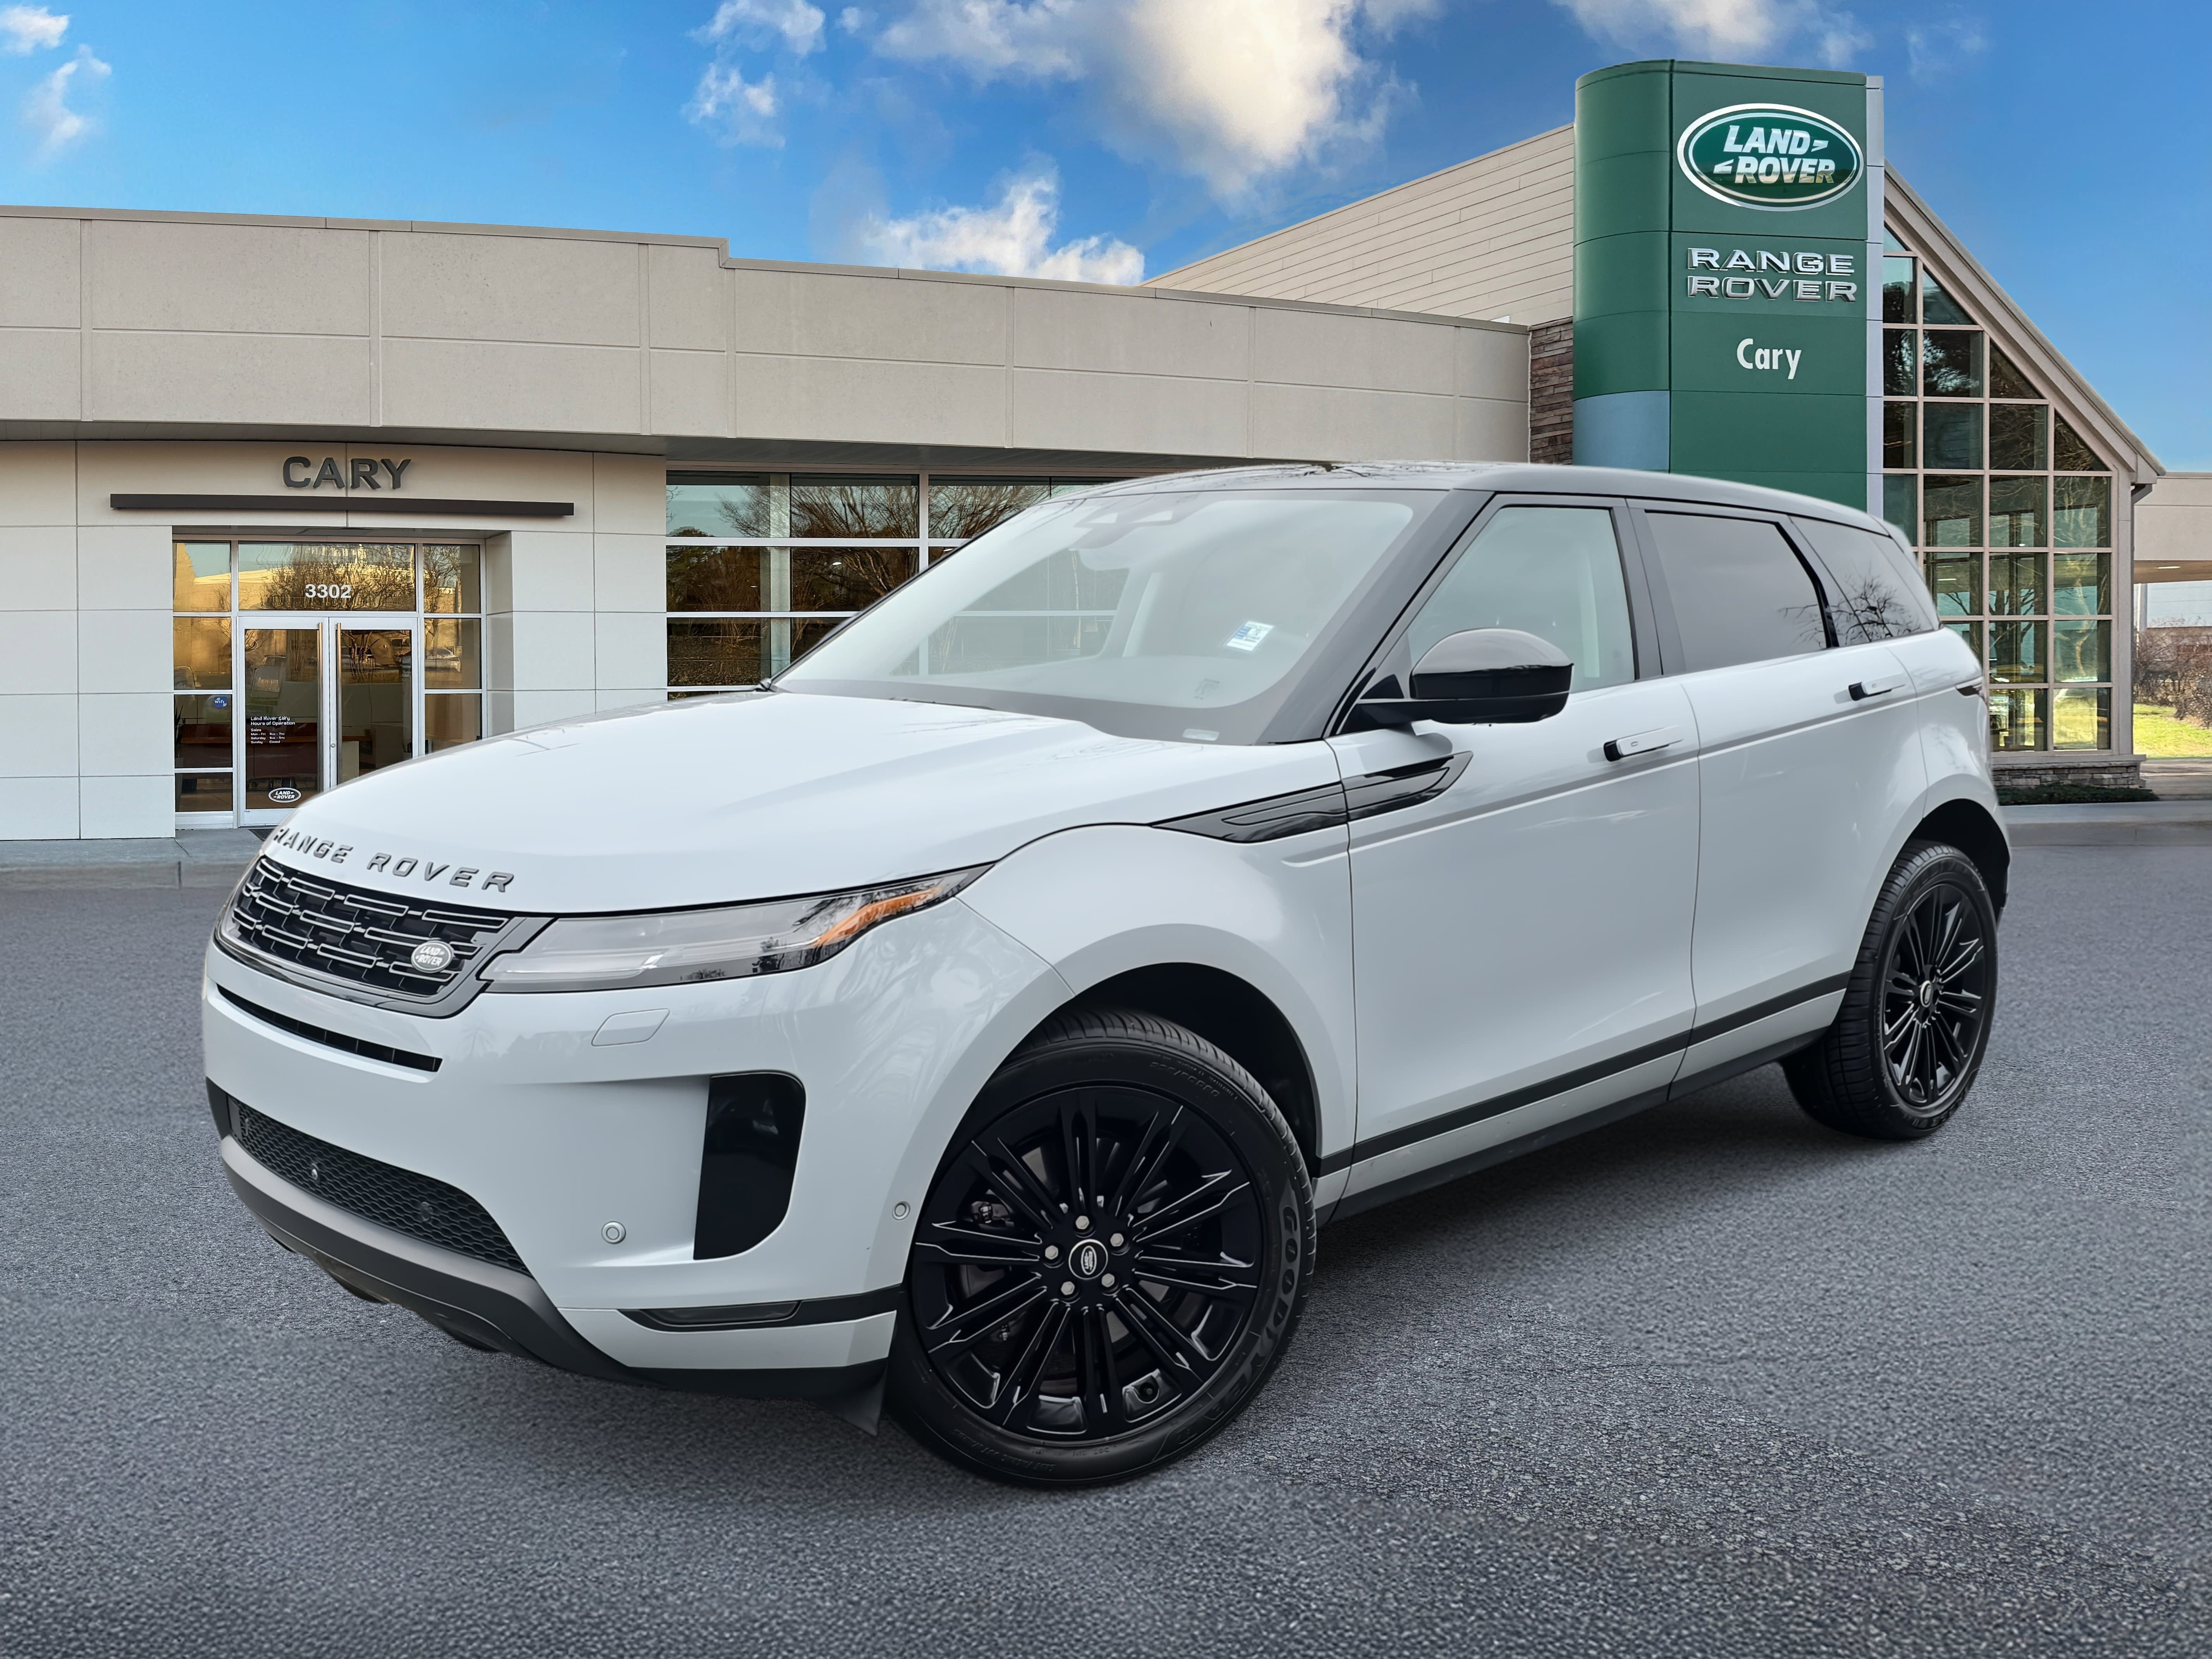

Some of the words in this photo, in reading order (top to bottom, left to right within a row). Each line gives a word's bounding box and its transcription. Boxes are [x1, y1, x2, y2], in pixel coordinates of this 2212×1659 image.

[1723, 125, 1811, 155] LAND
[1734, 156, 1836, 184] ROVER
[1688, 248, 1855, 276] RANGE
[1688, 276, 1857, 302] ROVER
[1736, 338, 1802, 380] Cary
[283, 456, 412, 489] CARY
[305, 584, 351, 598] 3302
[273, 828, 354, 864] RANGE
[367, 852, 515, 893] ROVER
[420, 946, 441, 956] LAND
